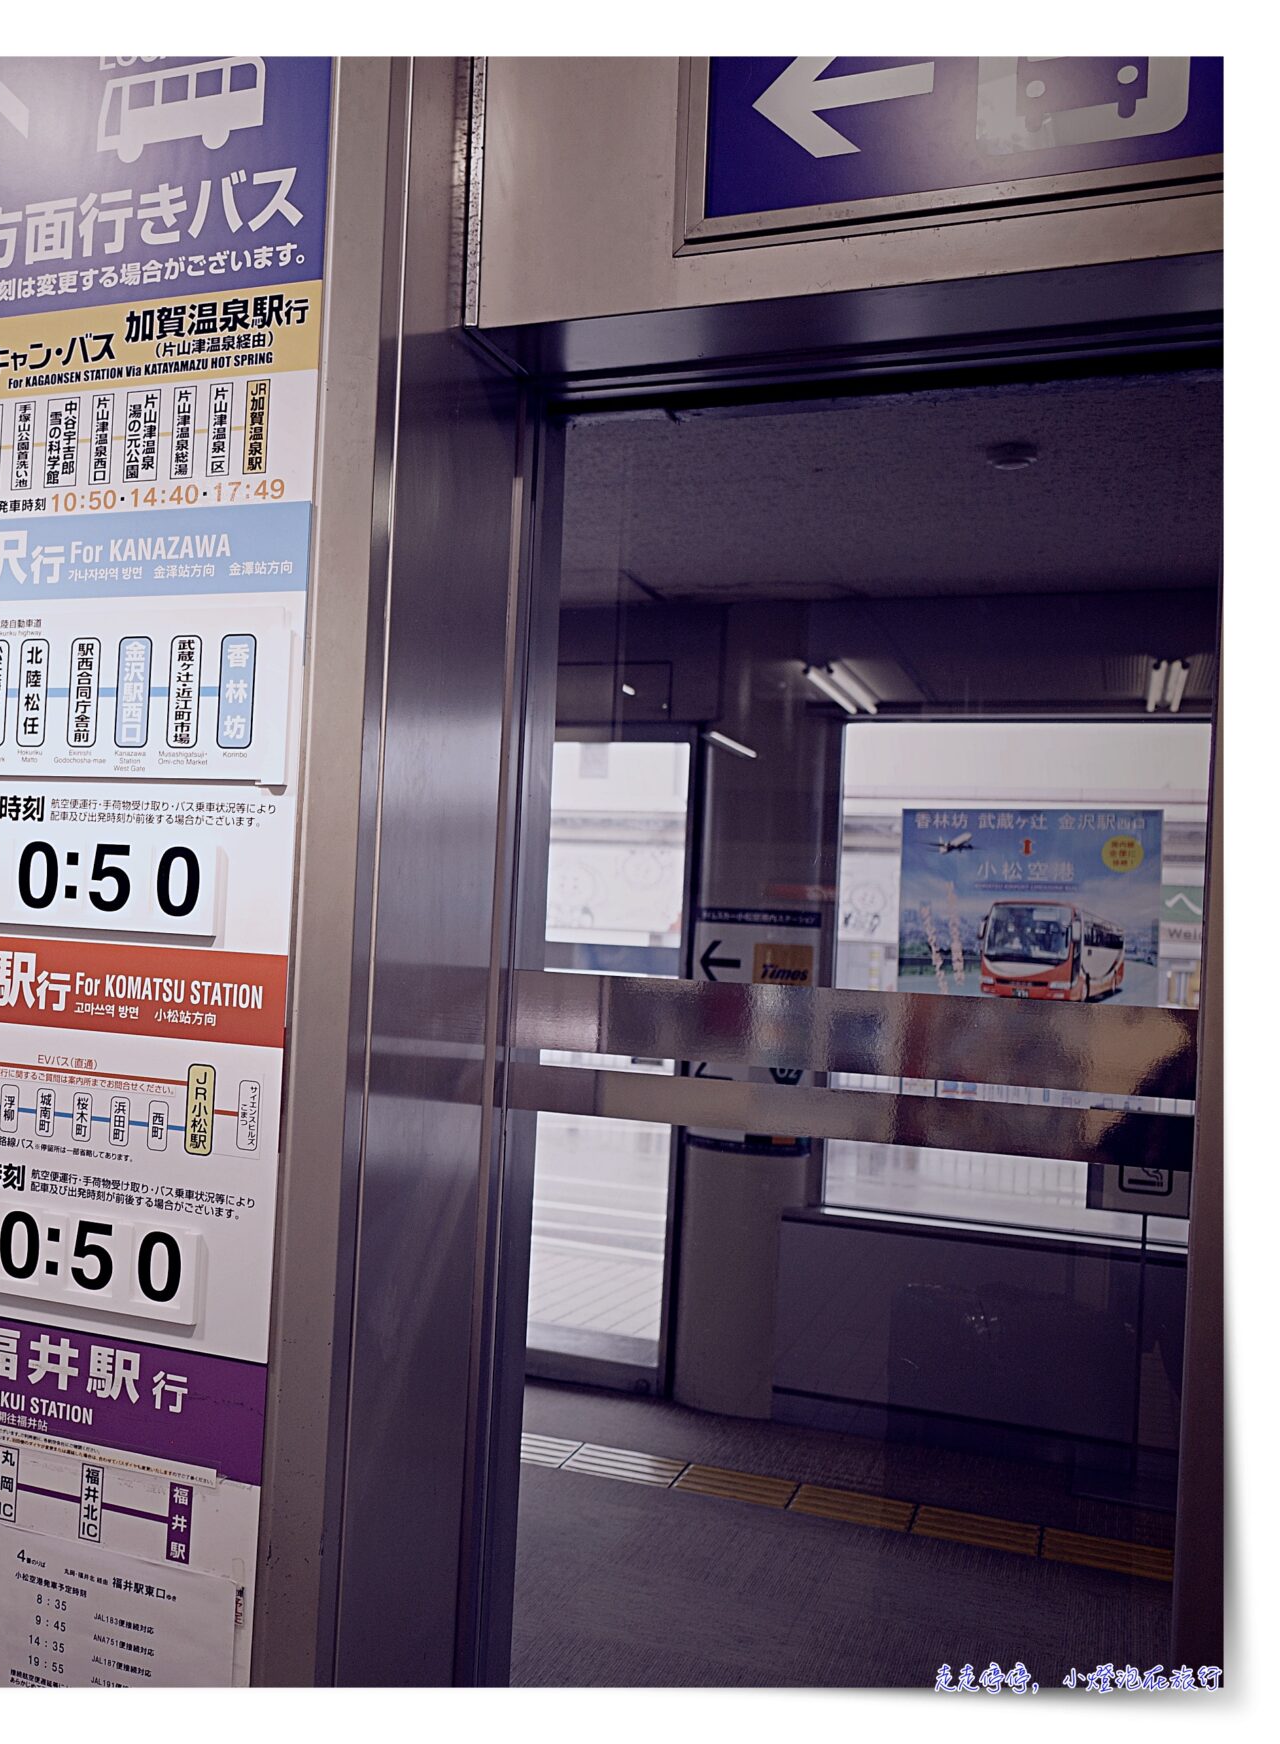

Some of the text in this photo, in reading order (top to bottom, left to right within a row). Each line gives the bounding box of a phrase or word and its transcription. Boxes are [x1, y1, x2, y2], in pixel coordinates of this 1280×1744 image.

[125, 293, 309, 343] 加賀温泉駅行
[8, 351, 273, 389] For KAGAONSEN STATION Via KATAYAMAZU HOT SPRING
[61, 400, 78, 475] 中谷宇吉郎
[93, 396, 111, 482] 片山津温泉西口
[125, 403, 142, 480] 湯の元公園
[141, 394, 158, 471] 片山津温泉
[174, 389, 192, 477] 片山津温泉総湯
[211, 386, 229, 474] 片山津温泉一区
[247, 382, 267, 472] JR加賀温泉駅
[46, 411, 63, 485] 雪の科学館
[70, 533, 232, 564] For KANAZAWA
[68, 566, 143, 582] 가나자와역 방면
[22, 646, 43, 735] 北陸松任
[73, 643, 95, 744] 駅西合同庁舎前
[119, 640, 147, 743] 金沢駅西口
[223, 643, 250, 740] 香林坊
[119, 757, 141, 765] Station
[186, 758, 208, 766] Market
[915, 813, 968, 829] 香林坊
[977, 861, 1075, 881] 小松空港
[74, 971, 263, 1010] For KOMATSU STATION
[760, 963, 808, 981] Times
[74, 1001, 139, 1020] 고마쓰역 방면
[154, 1008, 217, 1027] 小松站方向
[3, 1096, 16, 1122] 浮柳
[39, 1093, 52, 1133] 城南町
[75, 1097, 89, 1138] 桜木町
[113, 1101, 126, 1142] 浜田町
[151, 1112, 164, 1140] 西町
[190, 1072, 209, 1151] JR小松駅
[30, 1397, 93, 1425] STATION
[81, 1467, 101, 1539] 福井北IC
[169, 1486, 190, 1560] 福井駅
